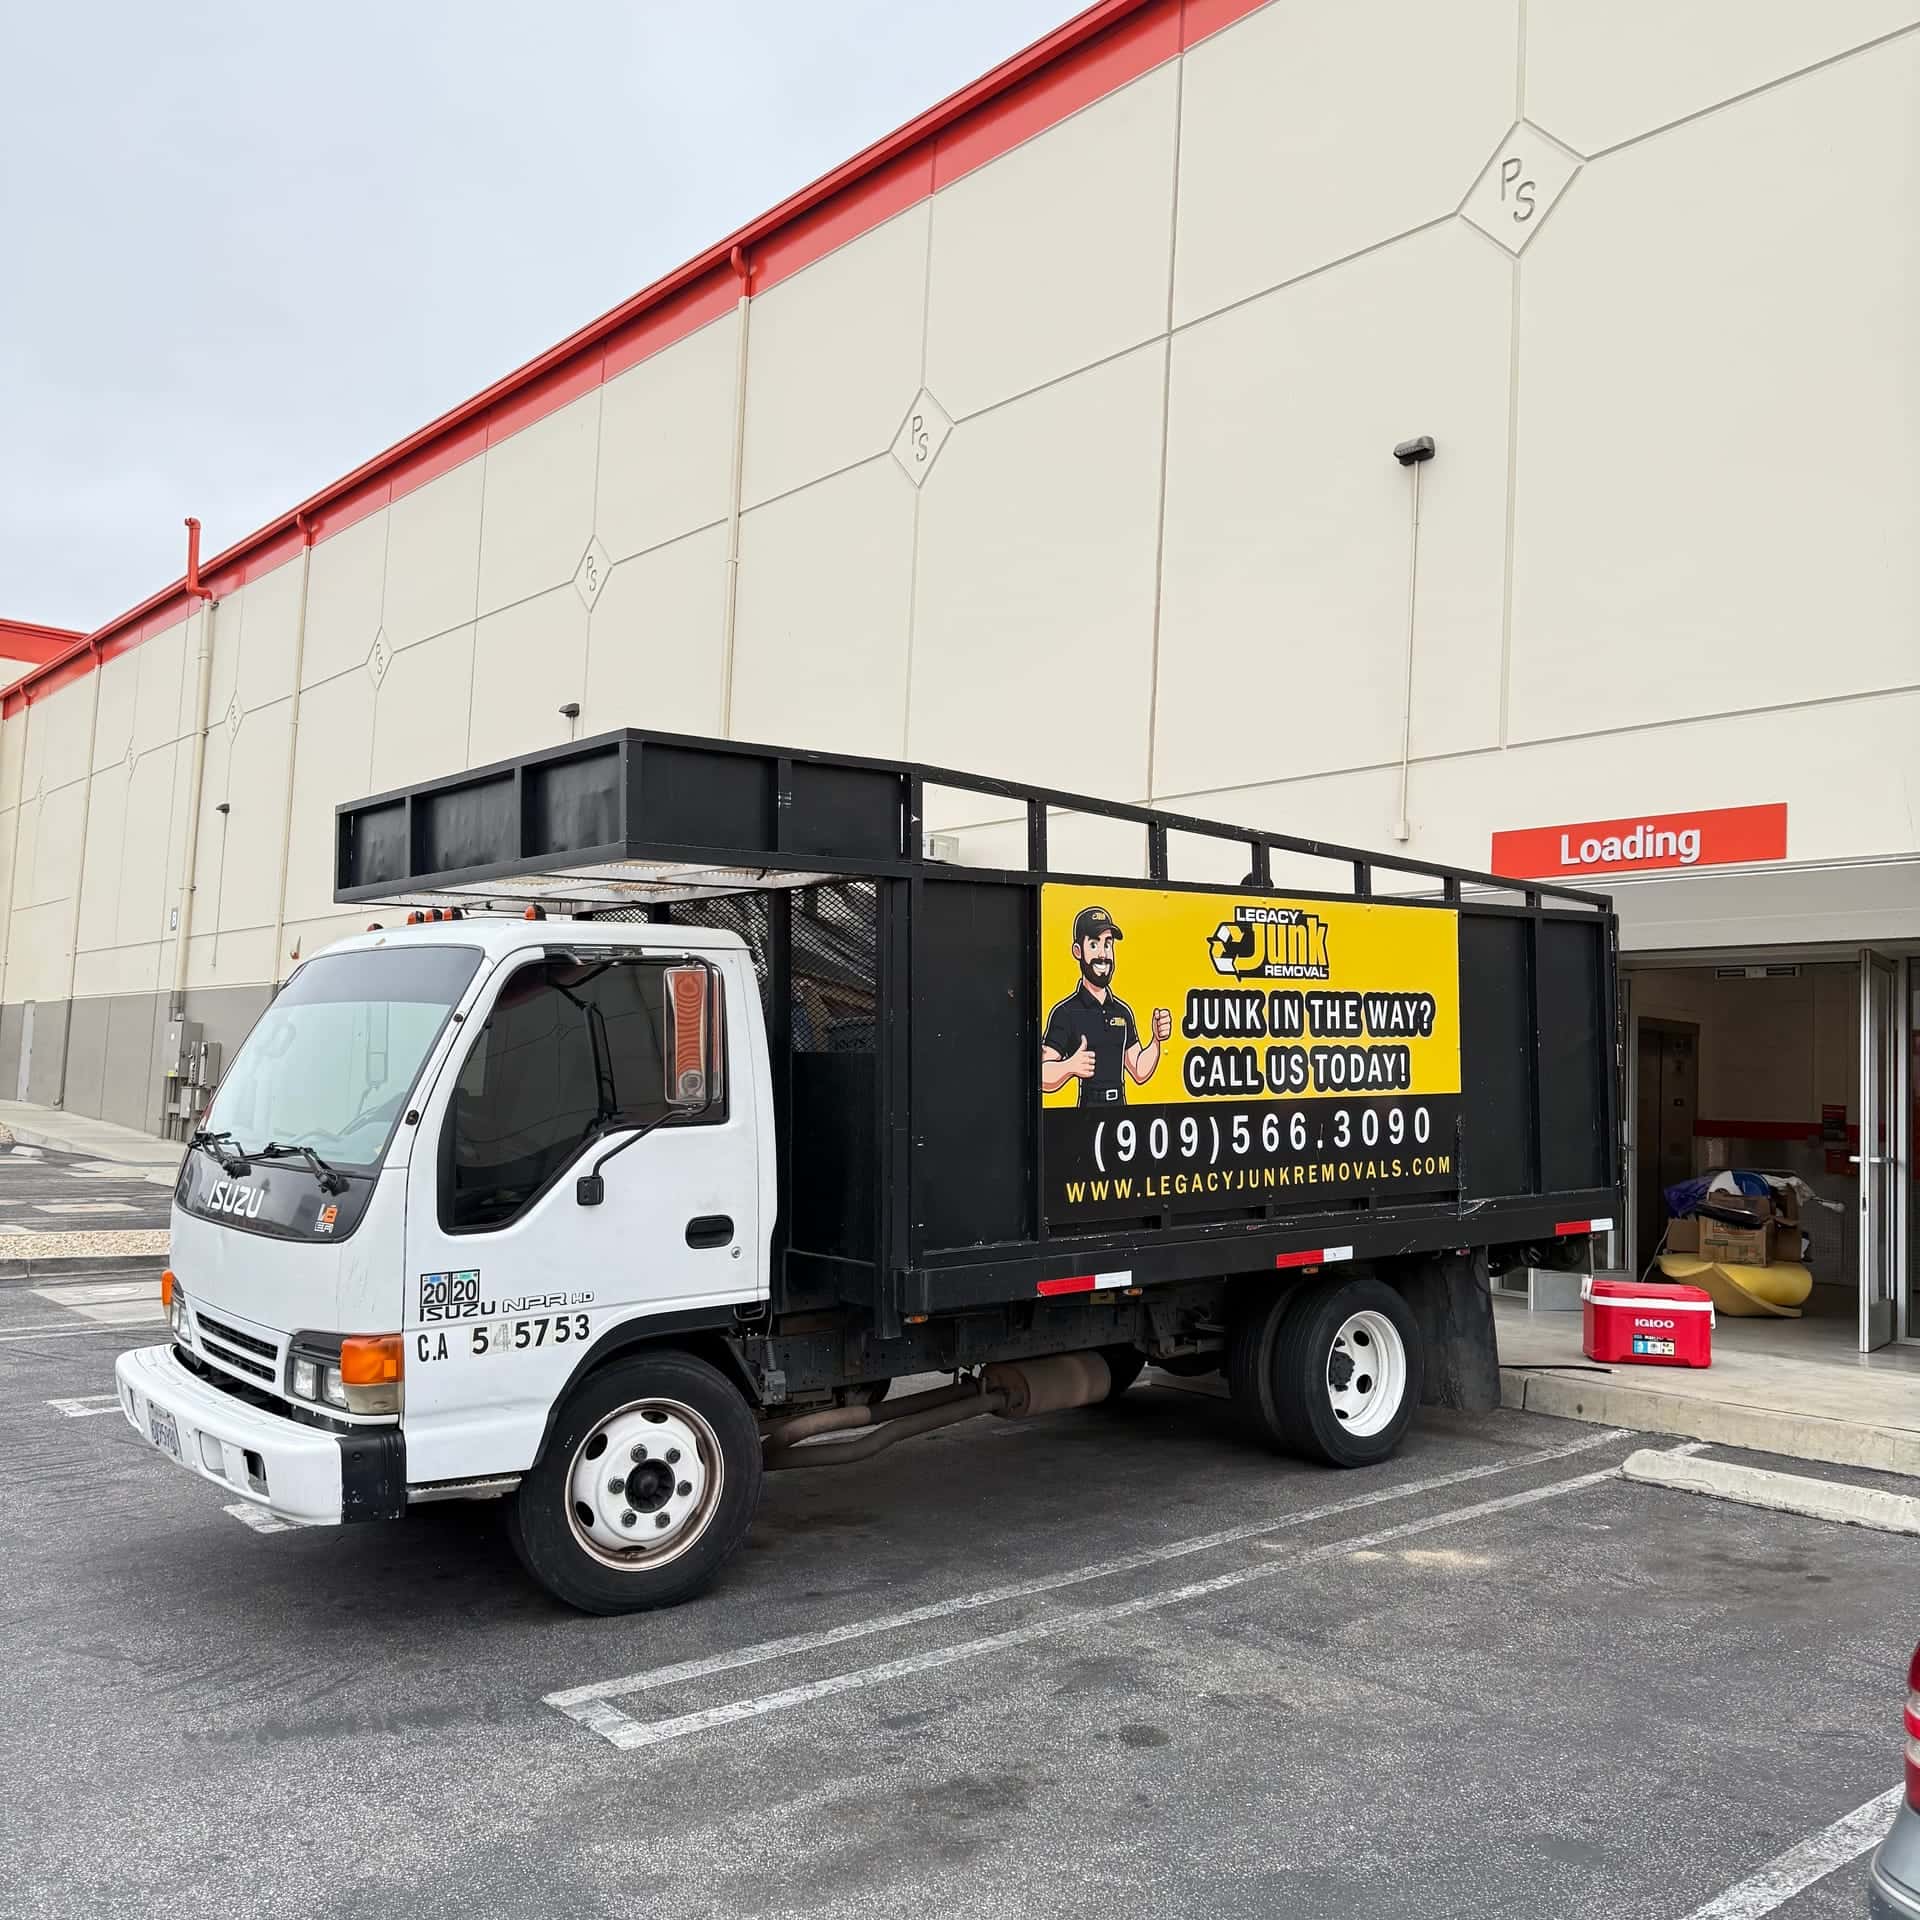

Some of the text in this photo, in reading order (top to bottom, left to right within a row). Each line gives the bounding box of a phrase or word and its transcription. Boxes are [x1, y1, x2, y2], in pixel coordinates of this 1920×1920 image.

[1560, 824, 1701, 865] Loading
[1235, 908, 1300, 924] LEGACY
[1233, 917, 1328, 971] Junk
[1264, 965, 1328, 978] REMOVAL
[1188, 998, 1433, 1030] JUNK IN THE WAY?
[1189, 1053, 1408, 1087] CALL US TODAY!
[1094, 1106, 1431, 1172] (909)566.3090
[1066, 1155, 1451, 1203] WWW.LEGACYJUNKREMOVALS.COM
[207, 1179, 265, 1219] ISUZU
[419, 1290, 595, 1323] ISUZU NPR HD
[1635, 1318, 1675, 1329] IGLOO
